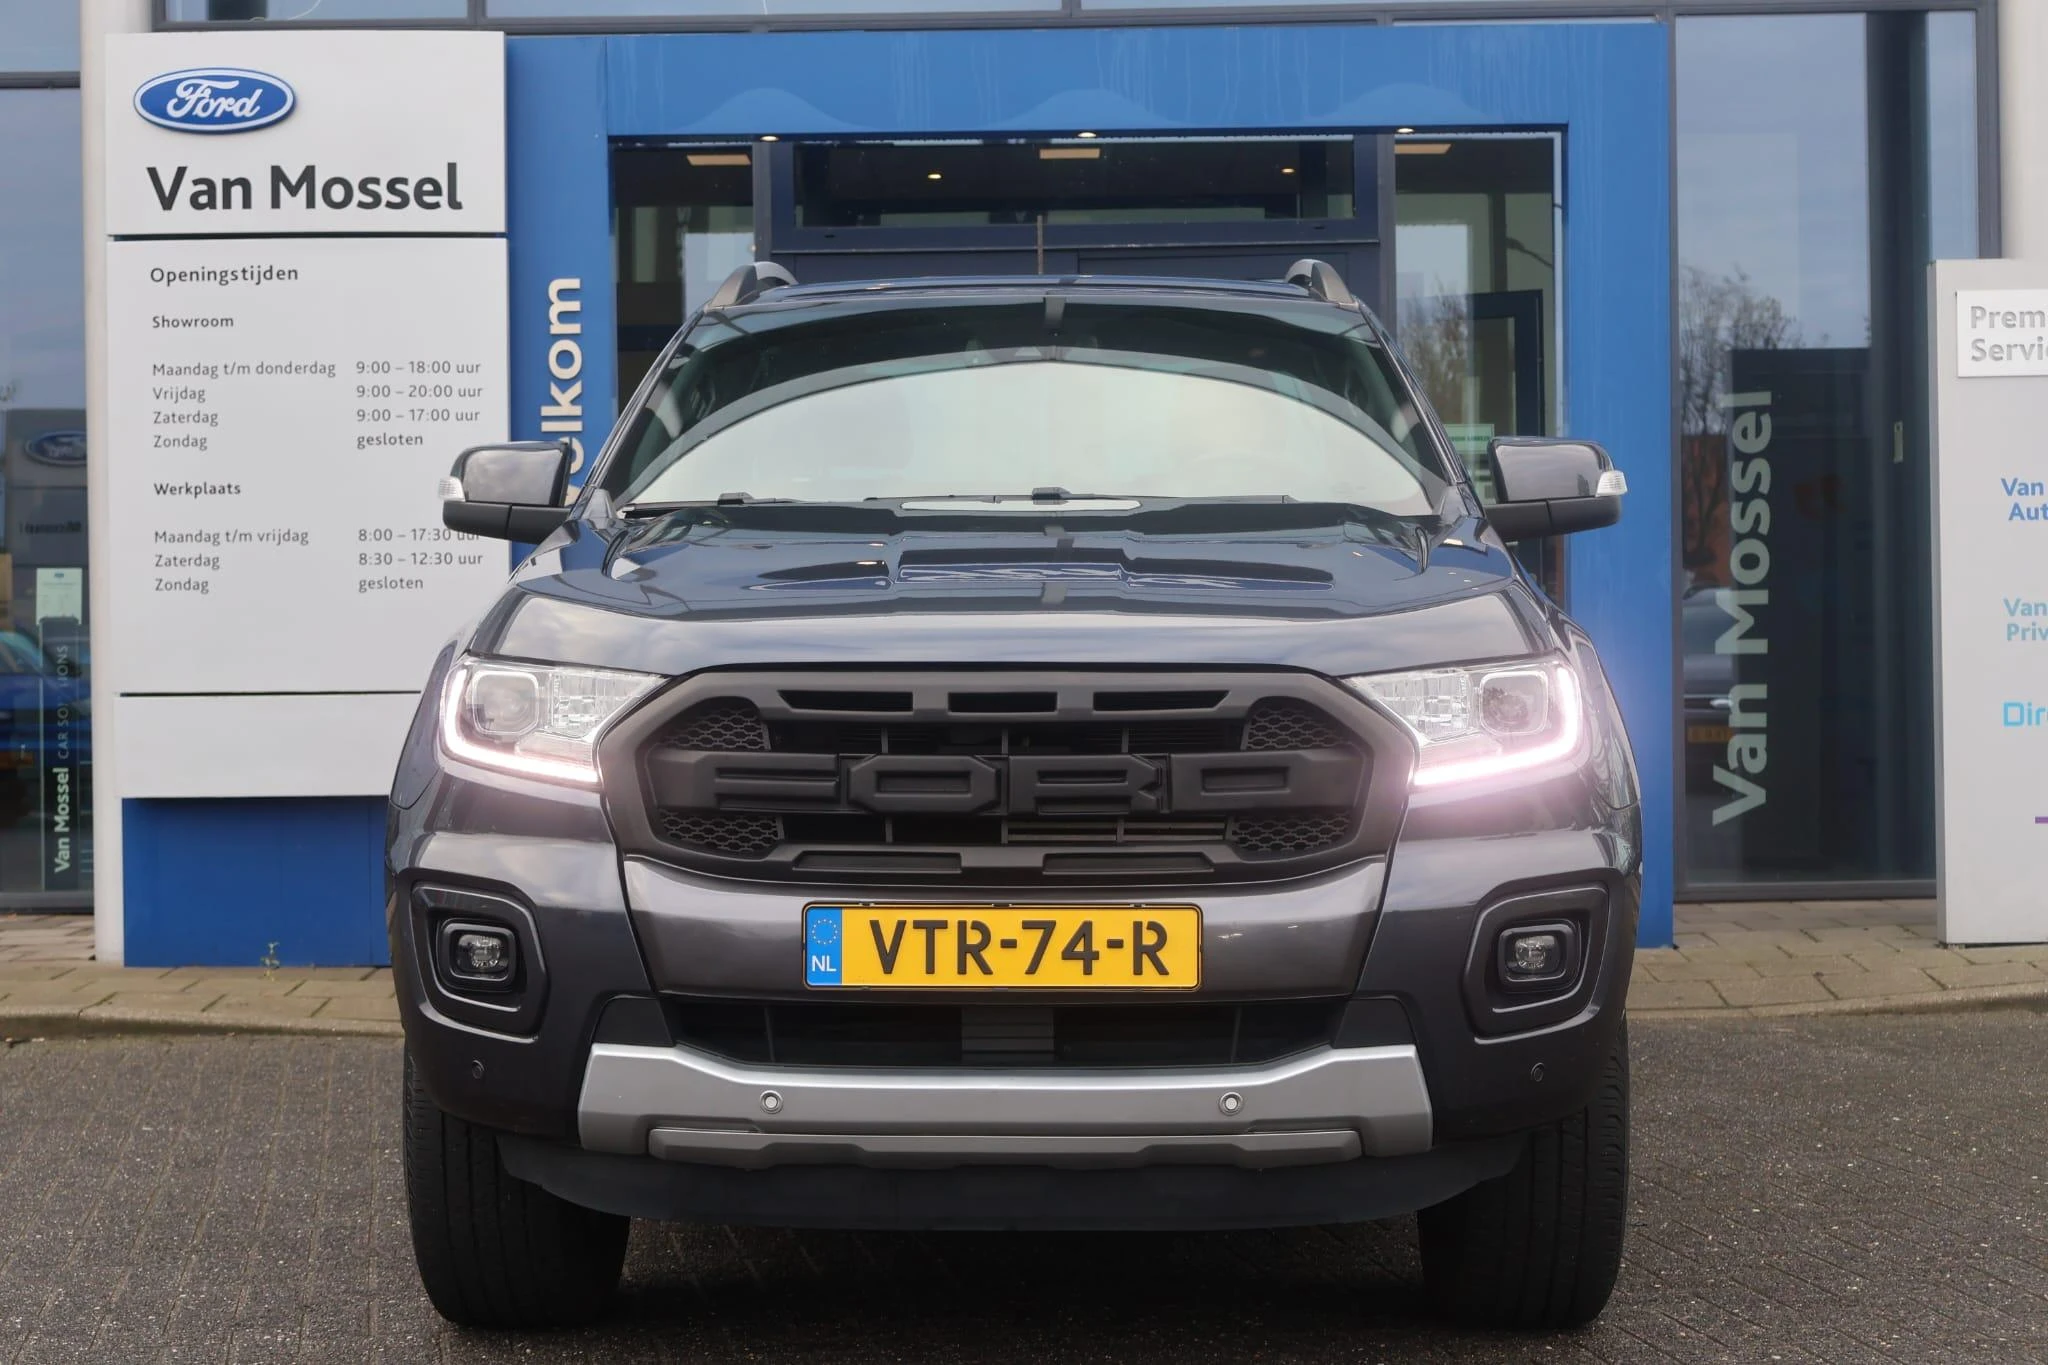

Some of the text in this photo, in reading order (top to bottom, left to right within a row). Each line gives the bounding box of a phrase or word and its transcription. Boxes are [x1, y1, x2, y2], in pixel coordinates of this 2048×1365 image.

[166, 78, 263, 118] Ford
[146, 162, 463, 211] Van Mossel
[150, 265, 299, 287] Openingstijden
[152, 314, 234, 329] Showroom
[1970, 305, 2048, 329] Prem
[1970, 335, 2048, 362] Servi
[152, 362, 219, 380] Maandag
[223, 361, 251, 376] t/m
[255, 360, 336, 379] donderdag
[355, 360, 391, 375] 9:00
[408, 360, 451, 374] 18:00
[456, 362, 481, 374] uur
[152, 386, 206, 405] Vrijdag
[356, 384, 391, 398] 9:00
[408, 384, 453, 398] 20:00
[457, 386, 483, 398] uur
[540, 277, 585, 506] lkom
[153, 410, 219, 428] Zaterdag
[356, 408, 392, 422] 9:00
[409, 408, 451, 422] 17:00
[455, 410, 481, 422] uur
[153, 432, 424, 451] Zondag gesloten
[153, 481, 241, 499] Werkplaats
[2000, 477, 2045, 497] Van
[2008, 502, 2048, 521] Aut
[154, 529, 221, 547] Maandag
[225, 528, 253, 544] t/m
[257, 528, 309, 546] vrijdag
[358, 528, 393, 542] 8:00
[411, 528, 452, 541] 17:30
[154, 553, 221, 571] Zaterdag
[358, 552, 393, 566] 8:30
[410, 552, 454, 565] 12:30
[458, 554, 484, 565] uur
[155, 575, 424, 595] Zondag gesloten
[1711, 391, 1772, 827] Van Mossel
[2003, 597, 2048, 617] Van
[2003, 701, 2048, 727] Dir
[57, 731, 69, 760] CAR
[52, 767, 70, 833] Mossel
[54, 837, 70, 873] Van
[869, 919, 1170, 976] VTR-74-R
[811, 954, 837, 972] NL
